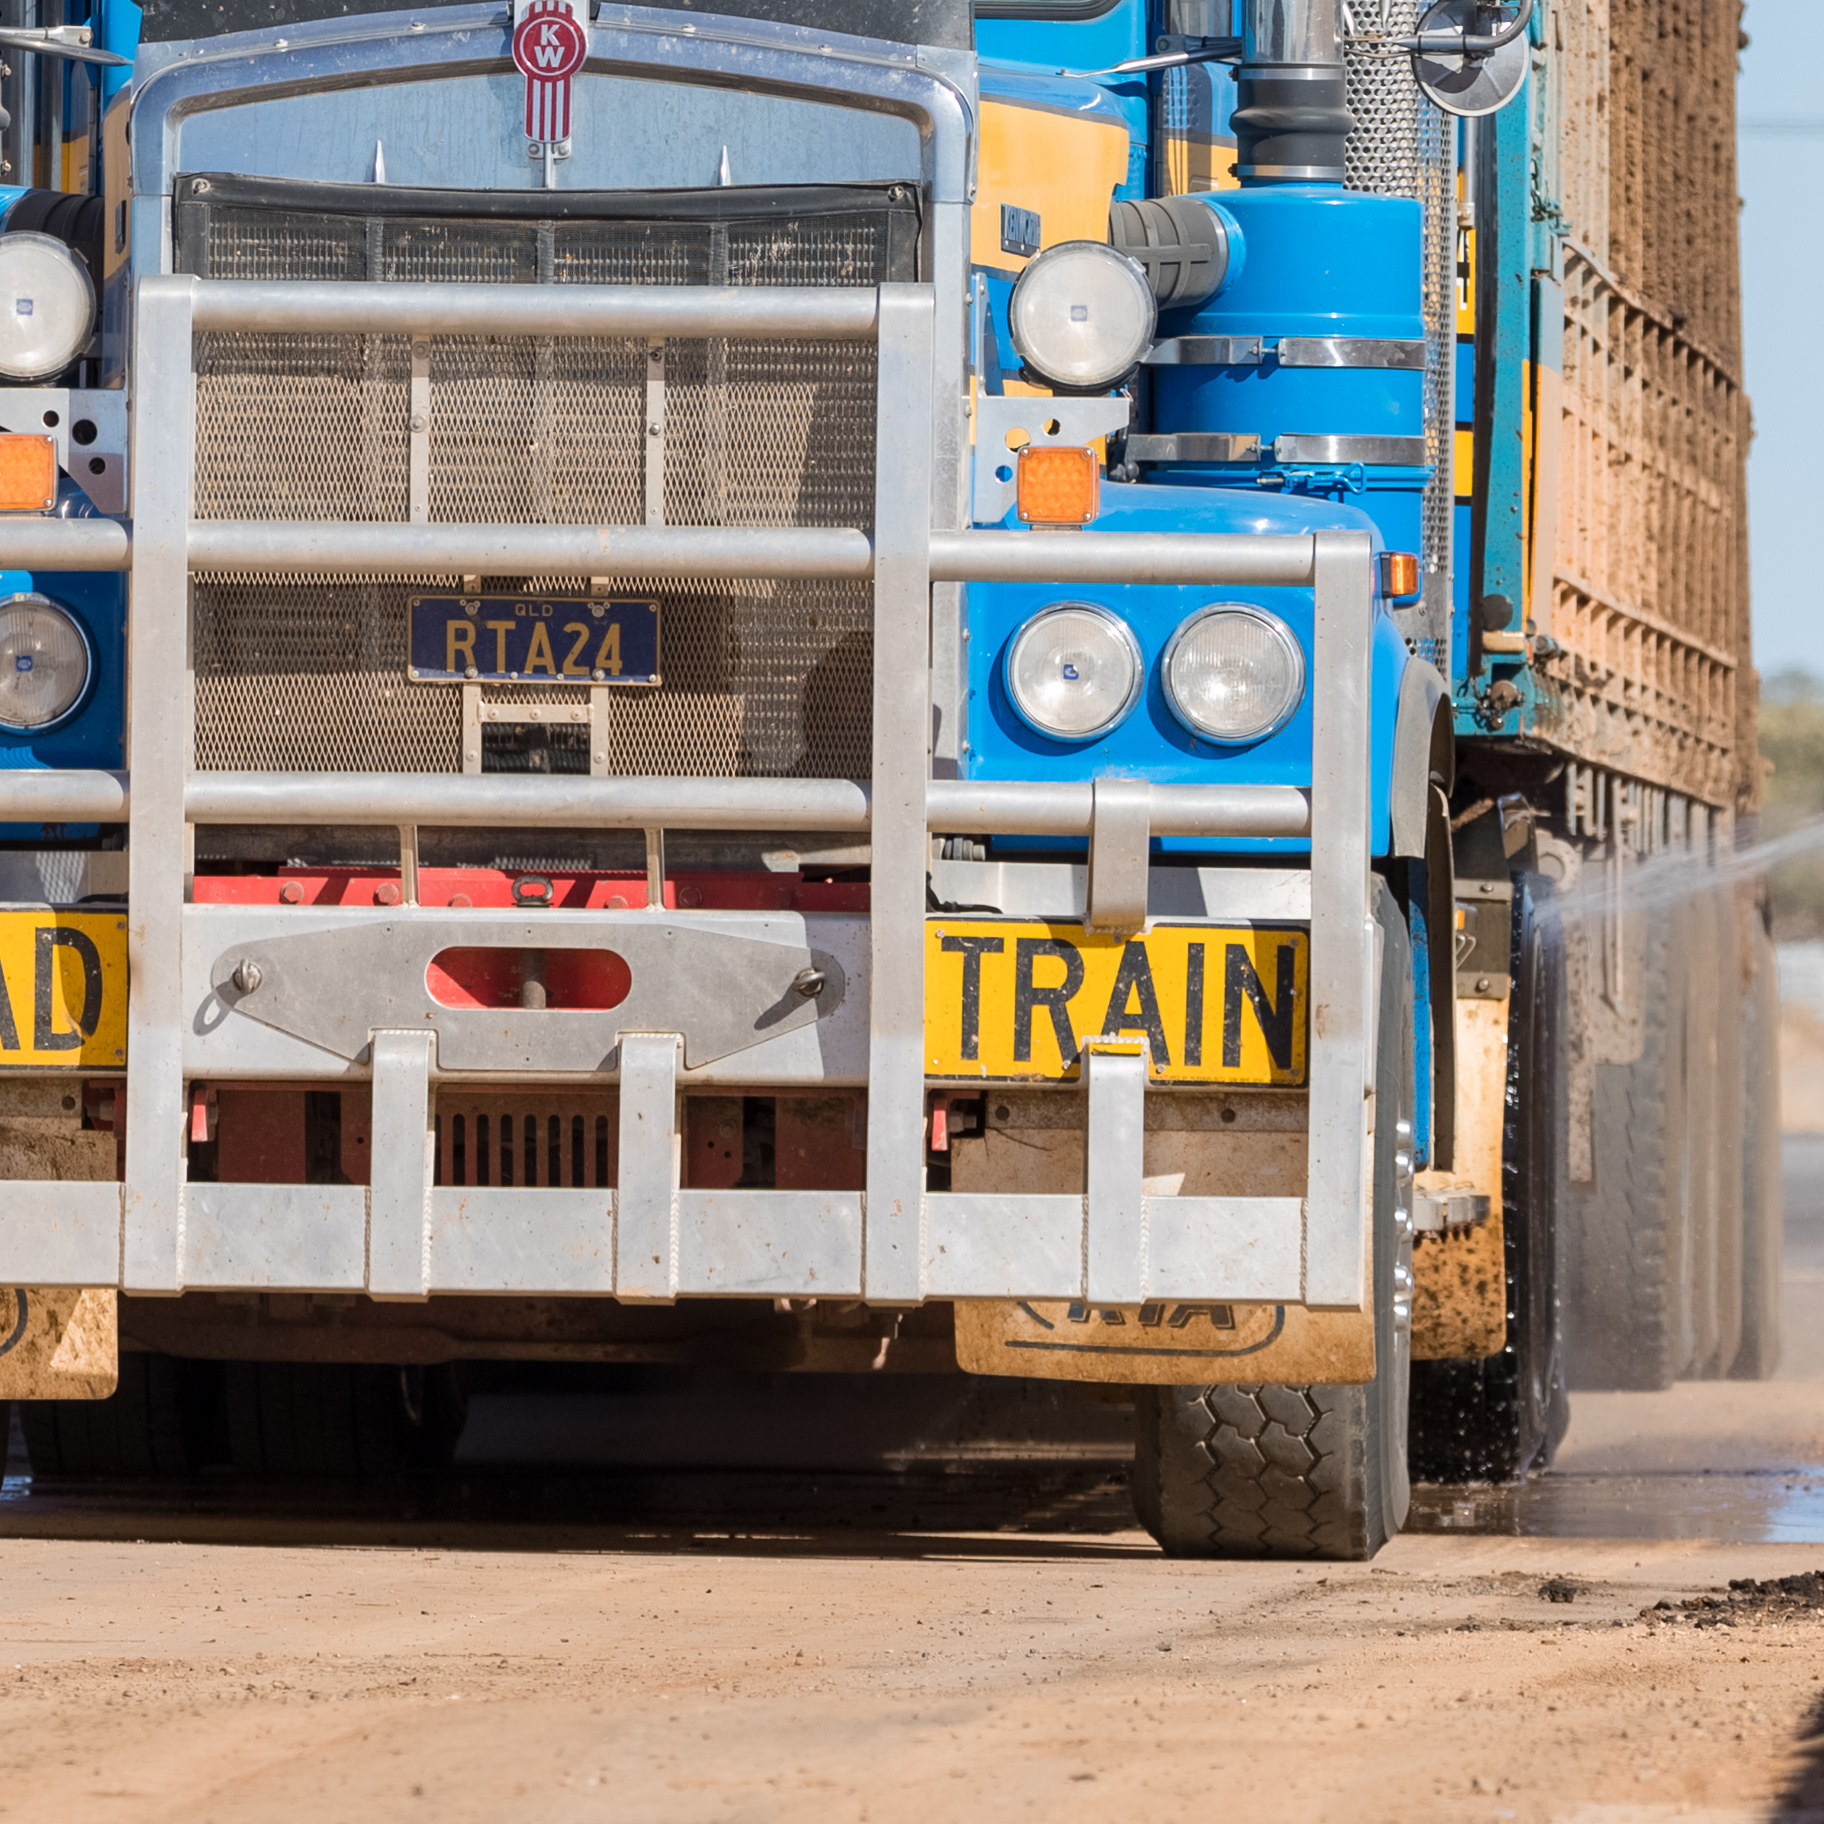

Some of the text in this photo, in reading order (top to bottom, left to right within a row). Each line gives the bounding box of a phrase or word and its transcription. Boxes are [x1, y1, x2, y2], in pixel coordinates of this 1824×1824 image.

[515, 603, 554, 617] QLD
[446, 619, 623, 677] RTA24
[941, 936, 1294, 1070] TRAIN
